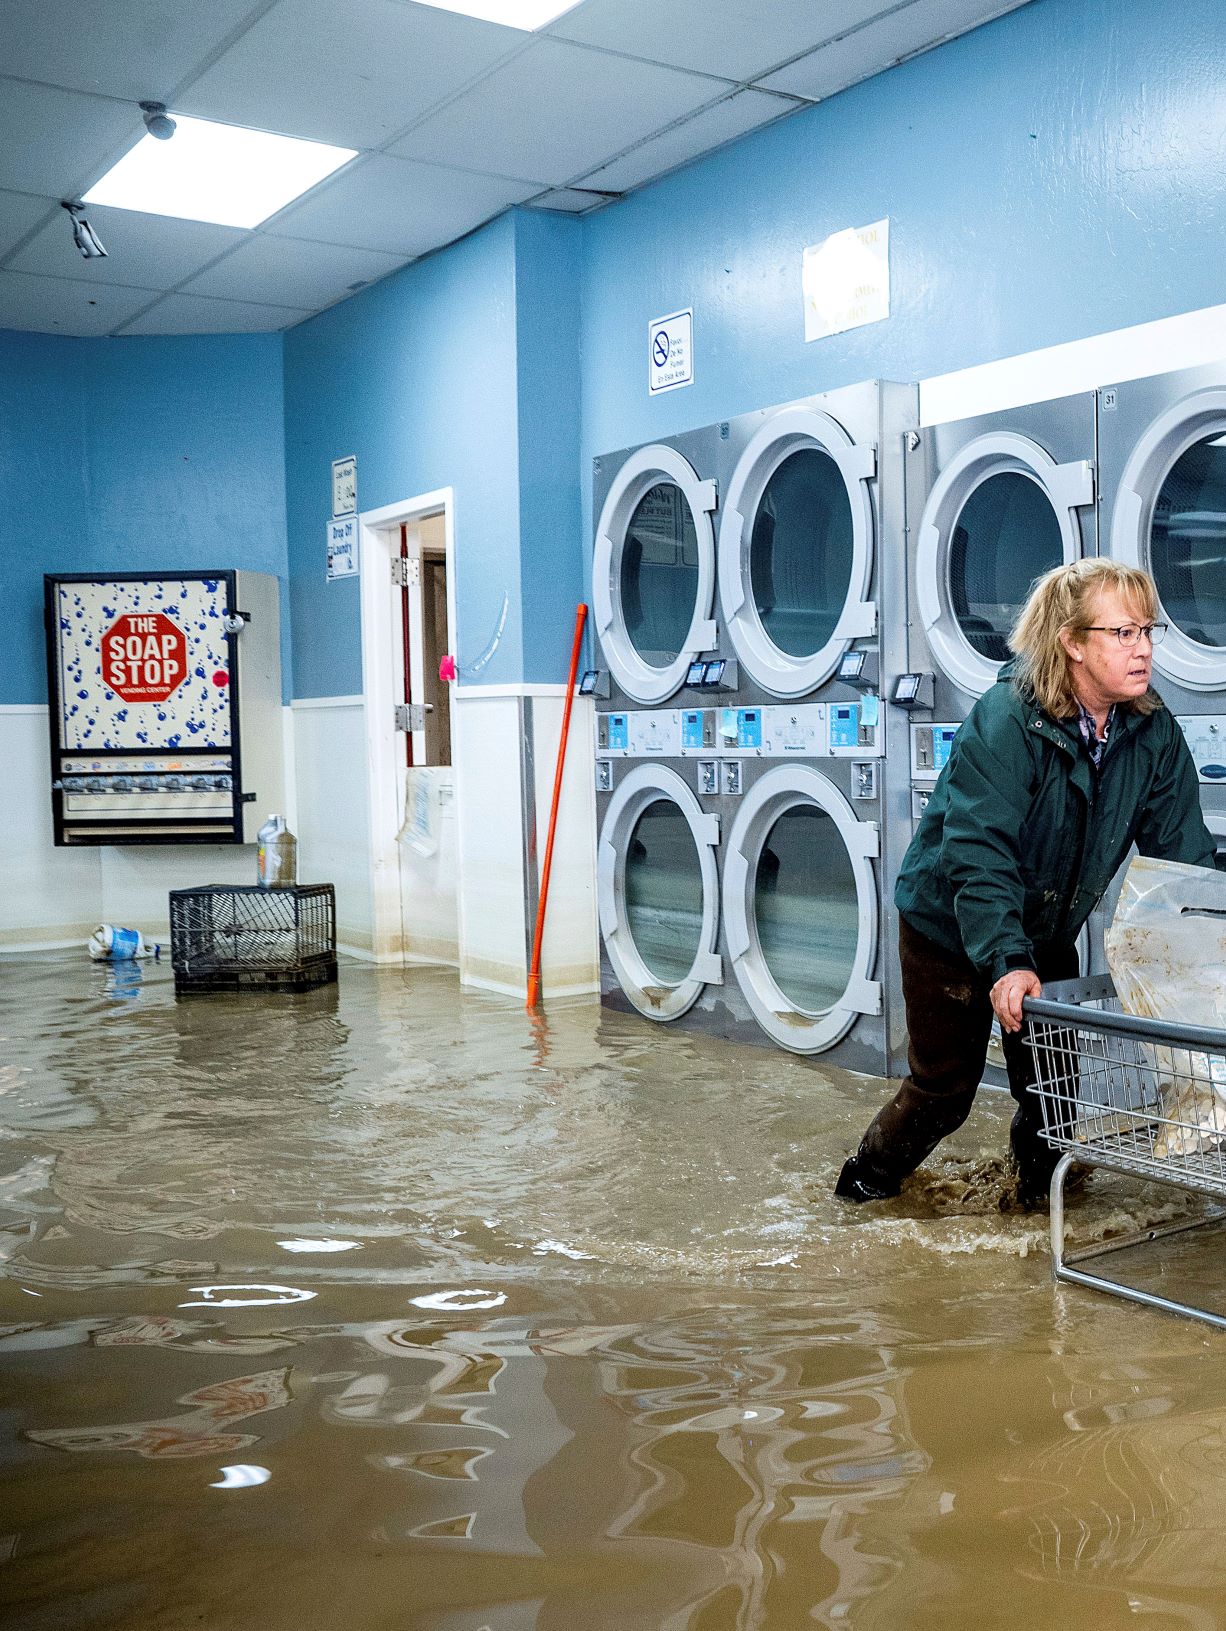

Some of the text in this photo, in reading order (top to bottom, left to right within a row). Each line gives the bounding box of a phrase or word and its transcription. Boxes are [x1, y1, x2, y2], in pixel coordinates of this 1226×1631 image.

[333, 526, 344, 541] Drop
[333, 543, 352, 557] Laundry
[127, 617, 158, 633] THE
[109, 634, 178, 660] SOAP
[110, 660, 179, 686] STOP
